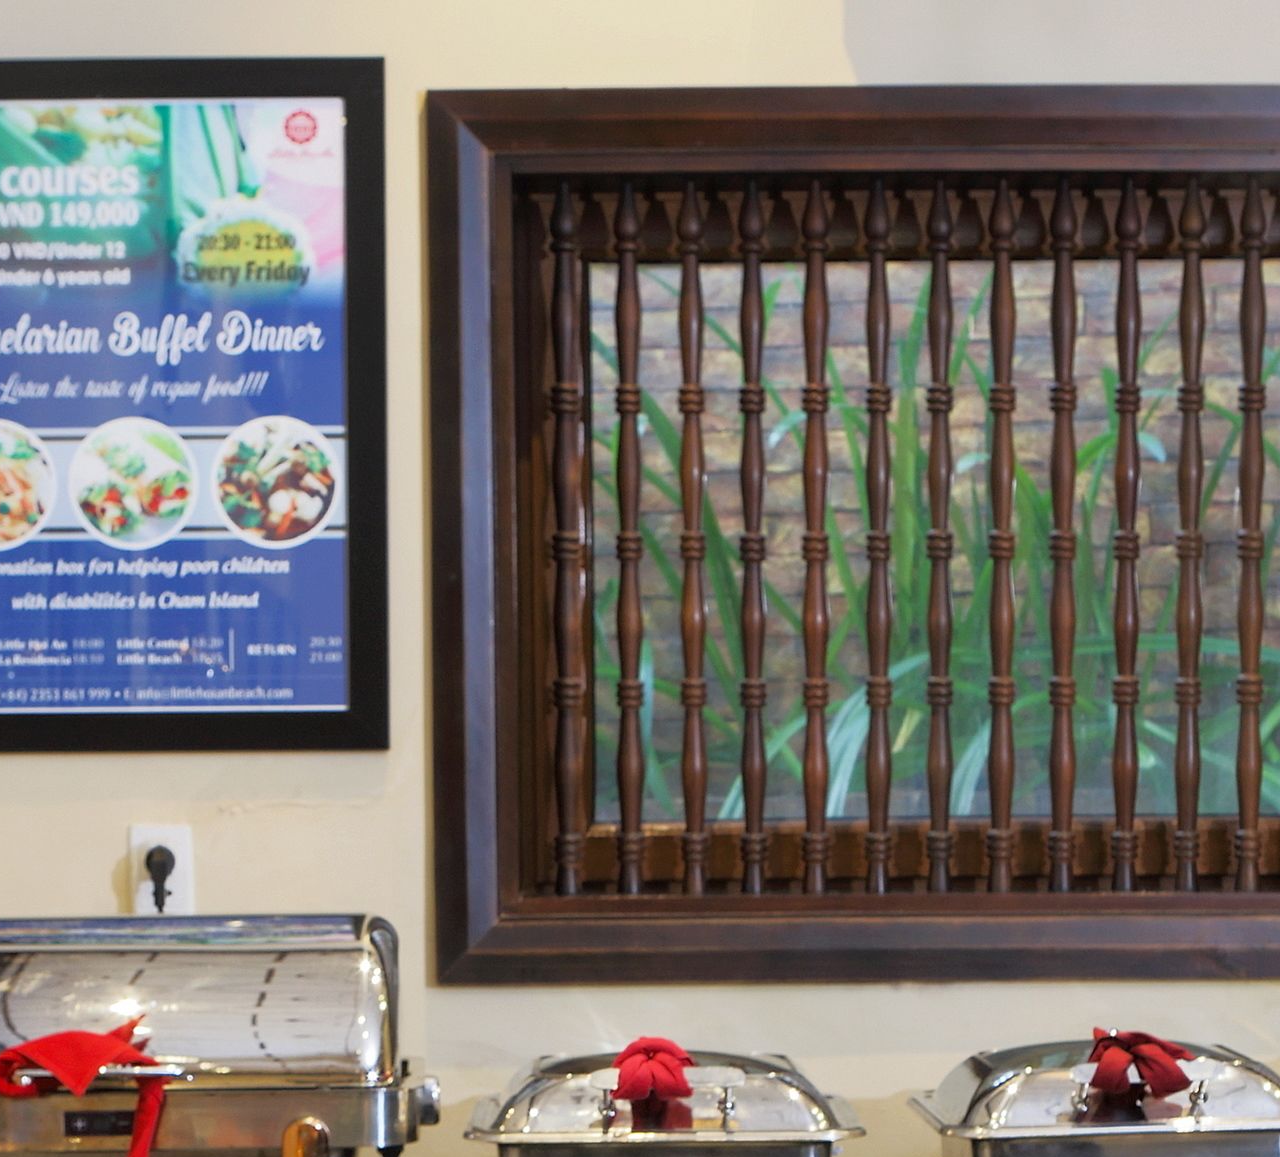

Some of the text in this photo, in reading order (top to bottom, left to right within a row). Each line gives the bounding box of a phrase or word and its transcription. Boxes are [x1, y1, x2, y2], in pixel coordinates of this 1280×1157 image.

[50, 200, 140, 229] 149,000
[182, 258, 311, 287] Every Friday
[216, 310, 326, 356] Dinner
[117, 557, 179, 577] helping
[222, 556, 290, 575] children
[158, 591, 206, 609] Cham
[209, 591, 260, 609] Island
